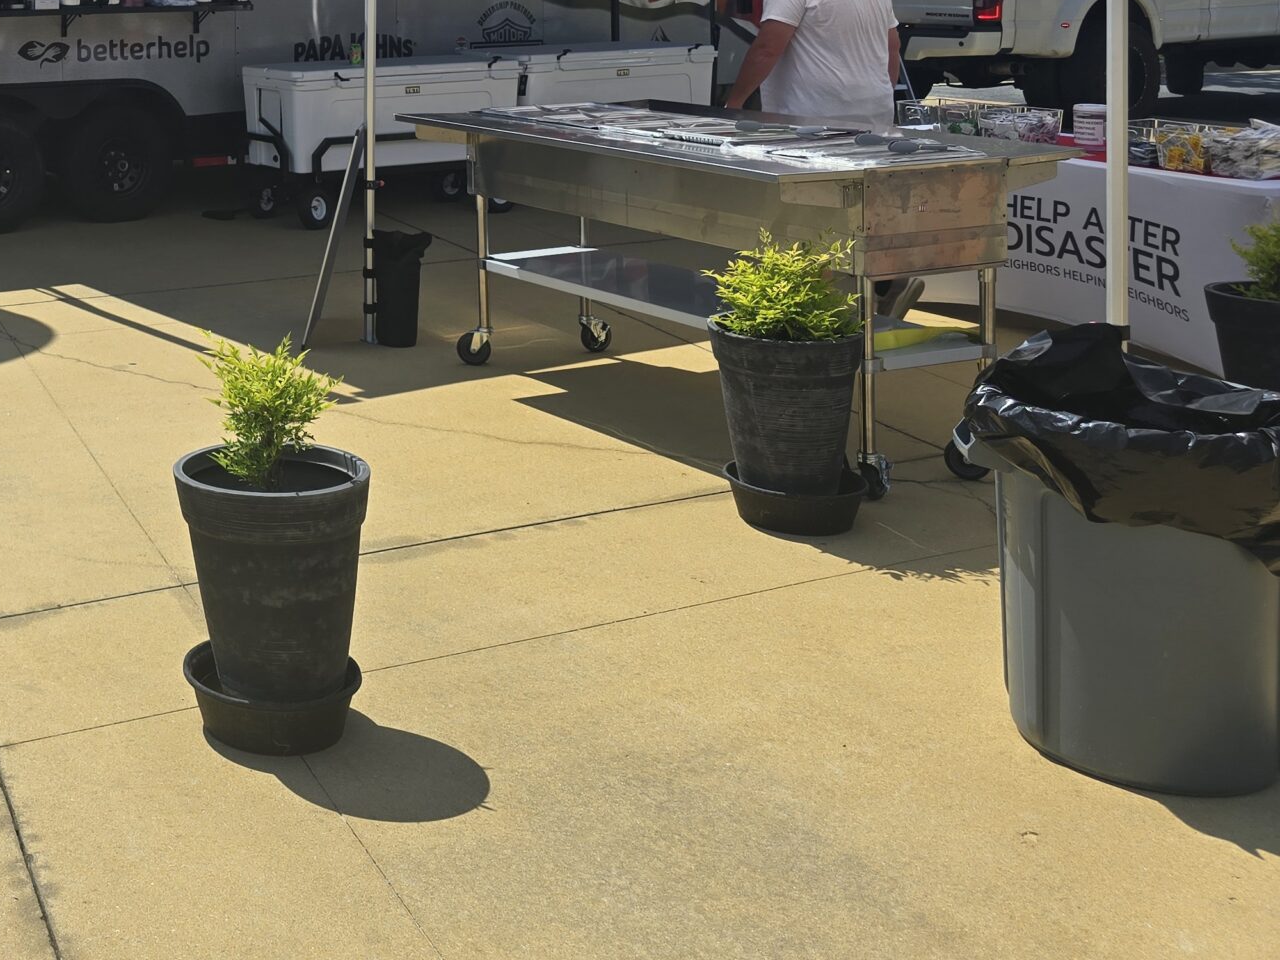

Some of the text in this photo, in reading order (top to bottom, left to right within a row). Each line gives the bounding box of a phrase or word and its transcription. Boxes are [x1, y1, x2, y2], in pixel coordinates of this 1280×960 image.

[76, 34, 210, 63] betterhelp
[294, 34, 346, 62] PAPA
[1082, 207, 1181, 257] ATER
[1007, 221, 1182, 298] DISASER
[1003, 258, 1191, 322] EIGHBORS HELPIN EIGHBORS
